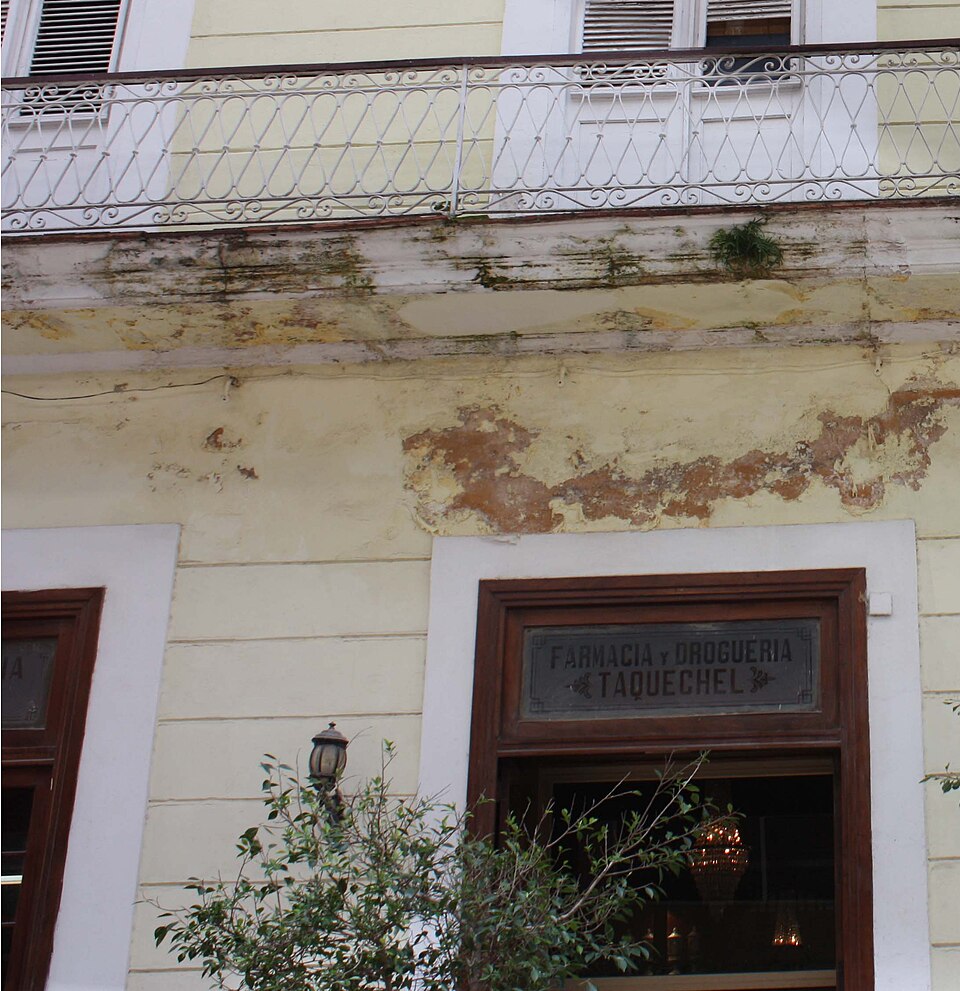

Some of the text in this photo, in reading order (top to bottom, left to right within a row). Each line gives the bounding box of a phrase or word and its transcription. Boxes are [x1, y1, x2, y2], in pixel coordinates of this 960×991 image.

[550, 642, 653, 669] FARMACIA
[675, 637, 793, 666] DROGUERIA
[598, 669, 744, 700] TAQUECHEL
